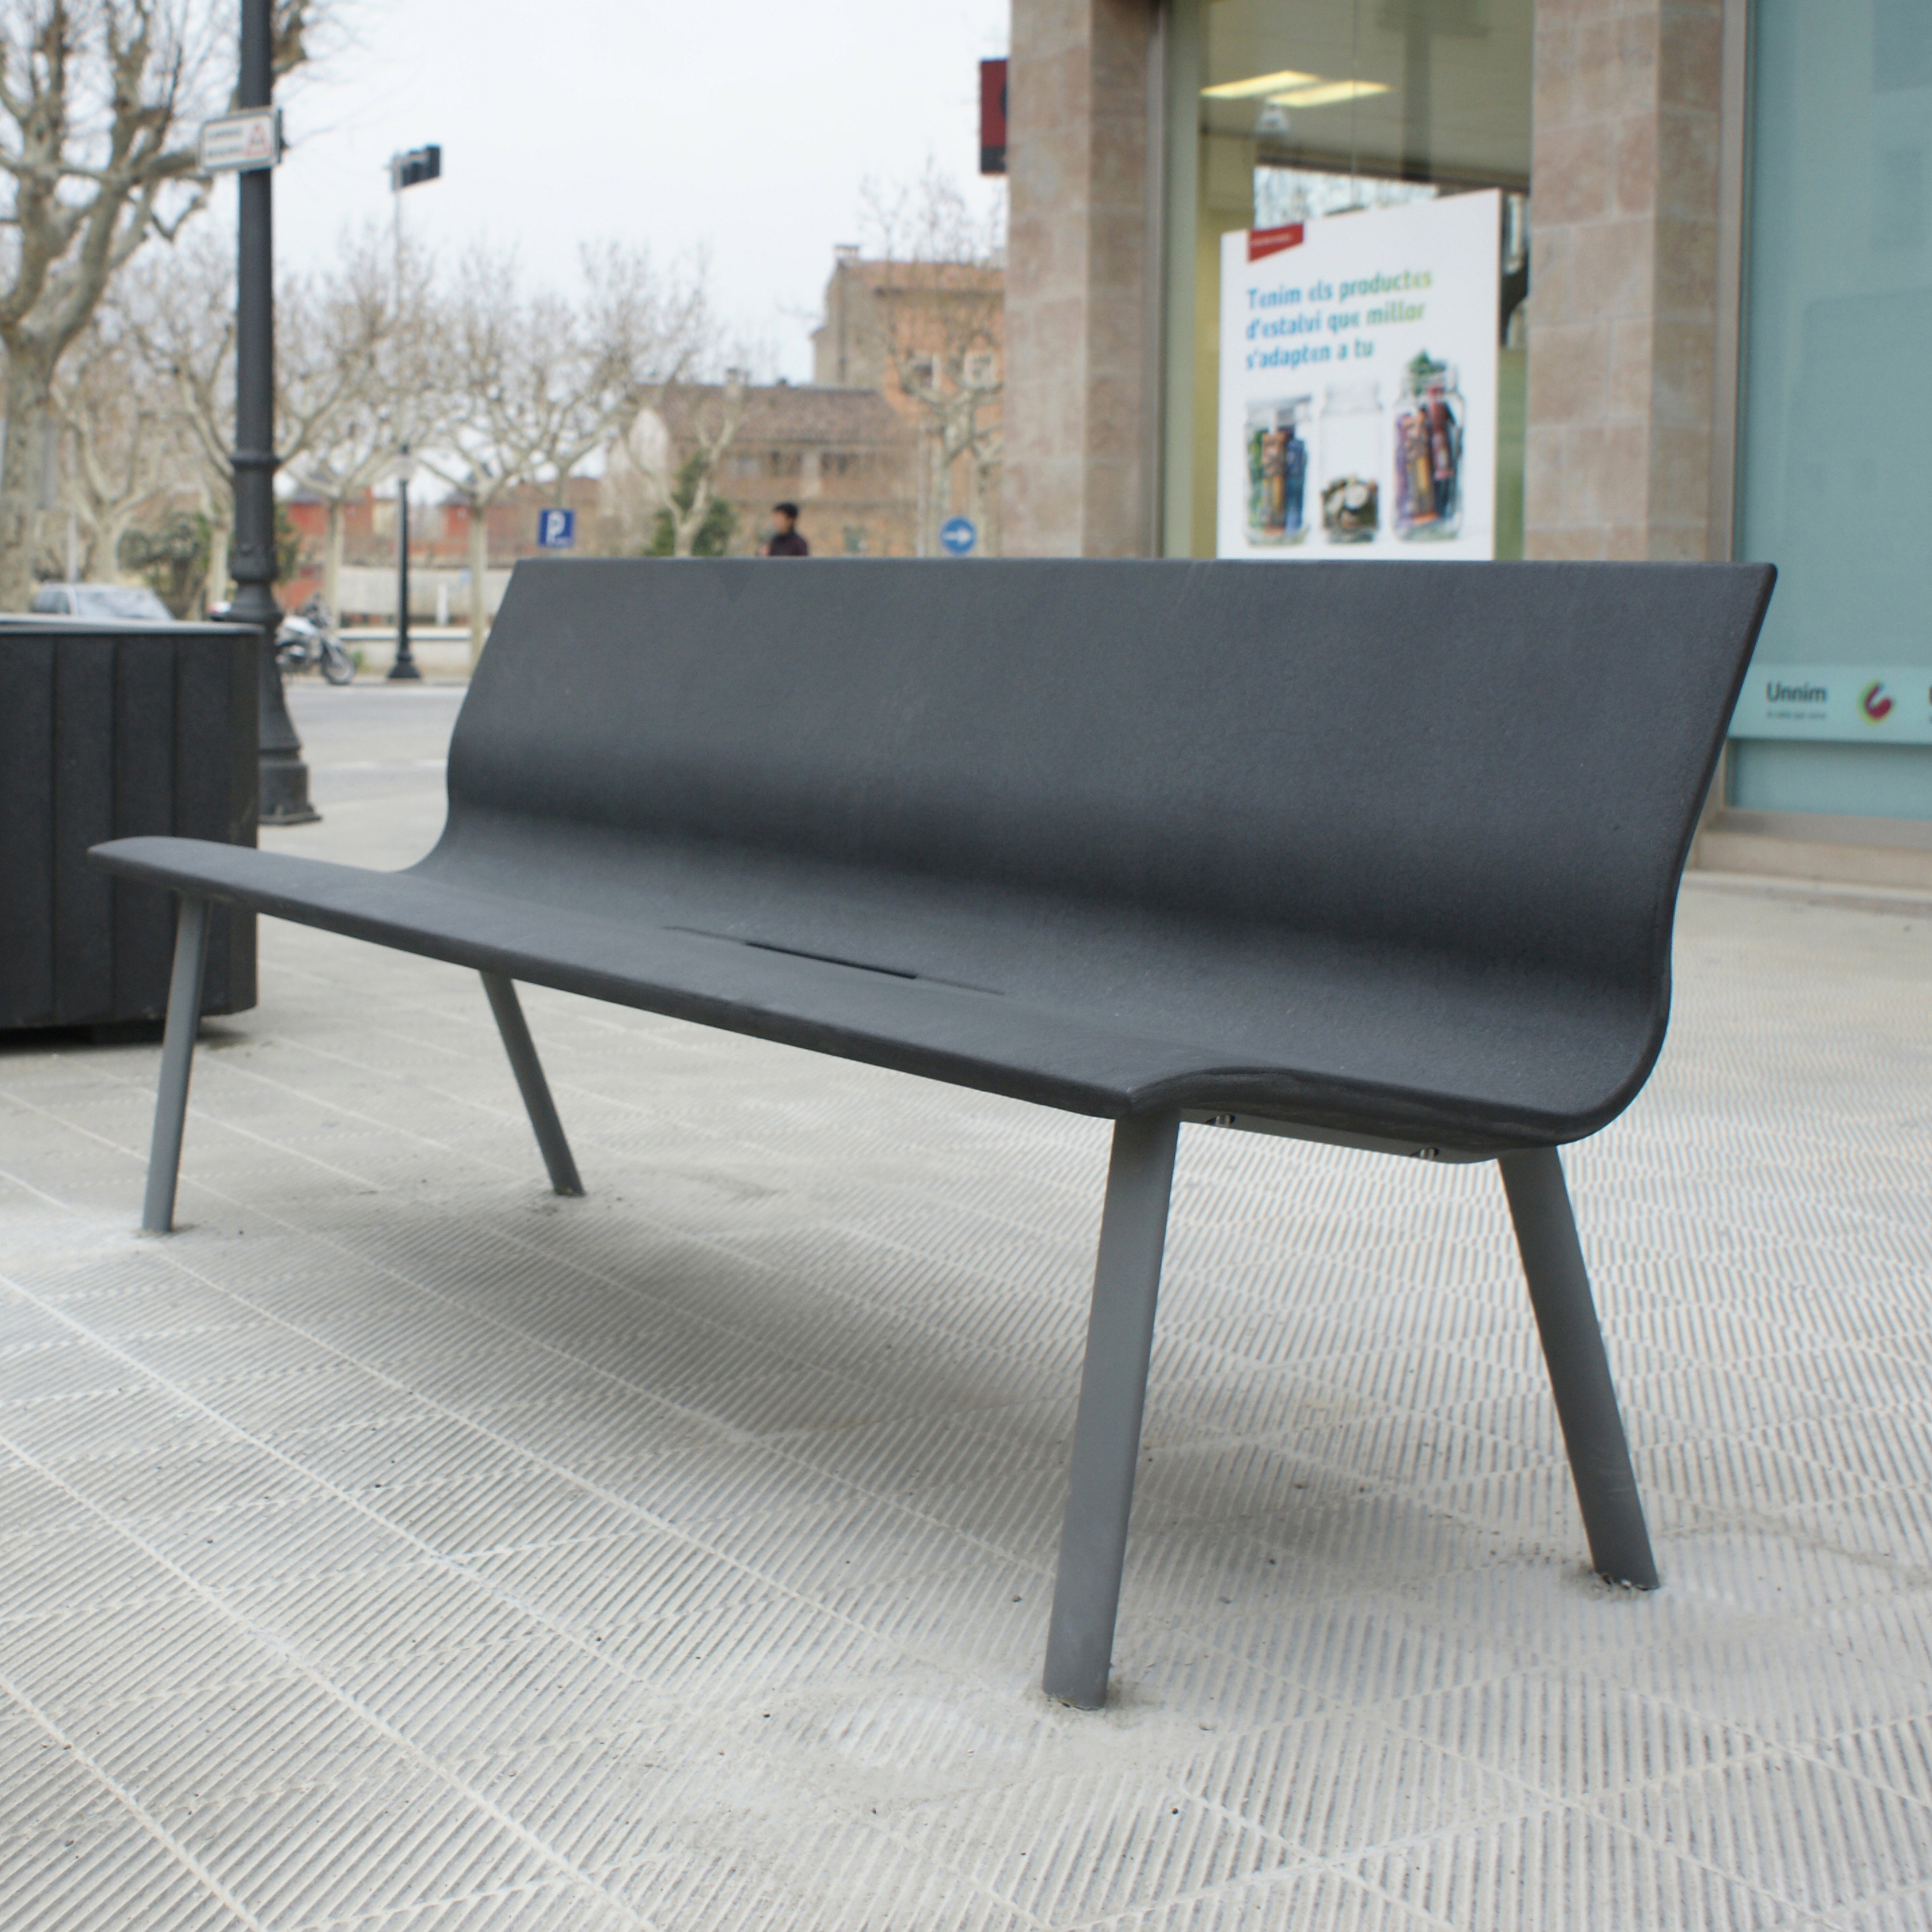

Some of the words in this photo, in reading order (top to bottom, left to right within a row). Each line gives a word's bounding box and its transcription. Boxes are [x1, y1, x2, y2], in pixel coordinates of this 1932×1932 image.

[1247, 284, 1301, 309] Tenim
[1309, 279, 1332, 301] els
[1339, 271, 1432, 301] productes
[1246, 311, 1321, 341] d'estalvi
[1328, 311, 1361, 334] que
[1366, 301, 1425, 326] millor
[1247, 343, 1330, 370] s'adapten
[1338, 343, 1349, 360] a
[1355, 339, 1374, 358] tu
[547, 511, 565, 543] P
[1766, 682, 1827, 703] Unnim
